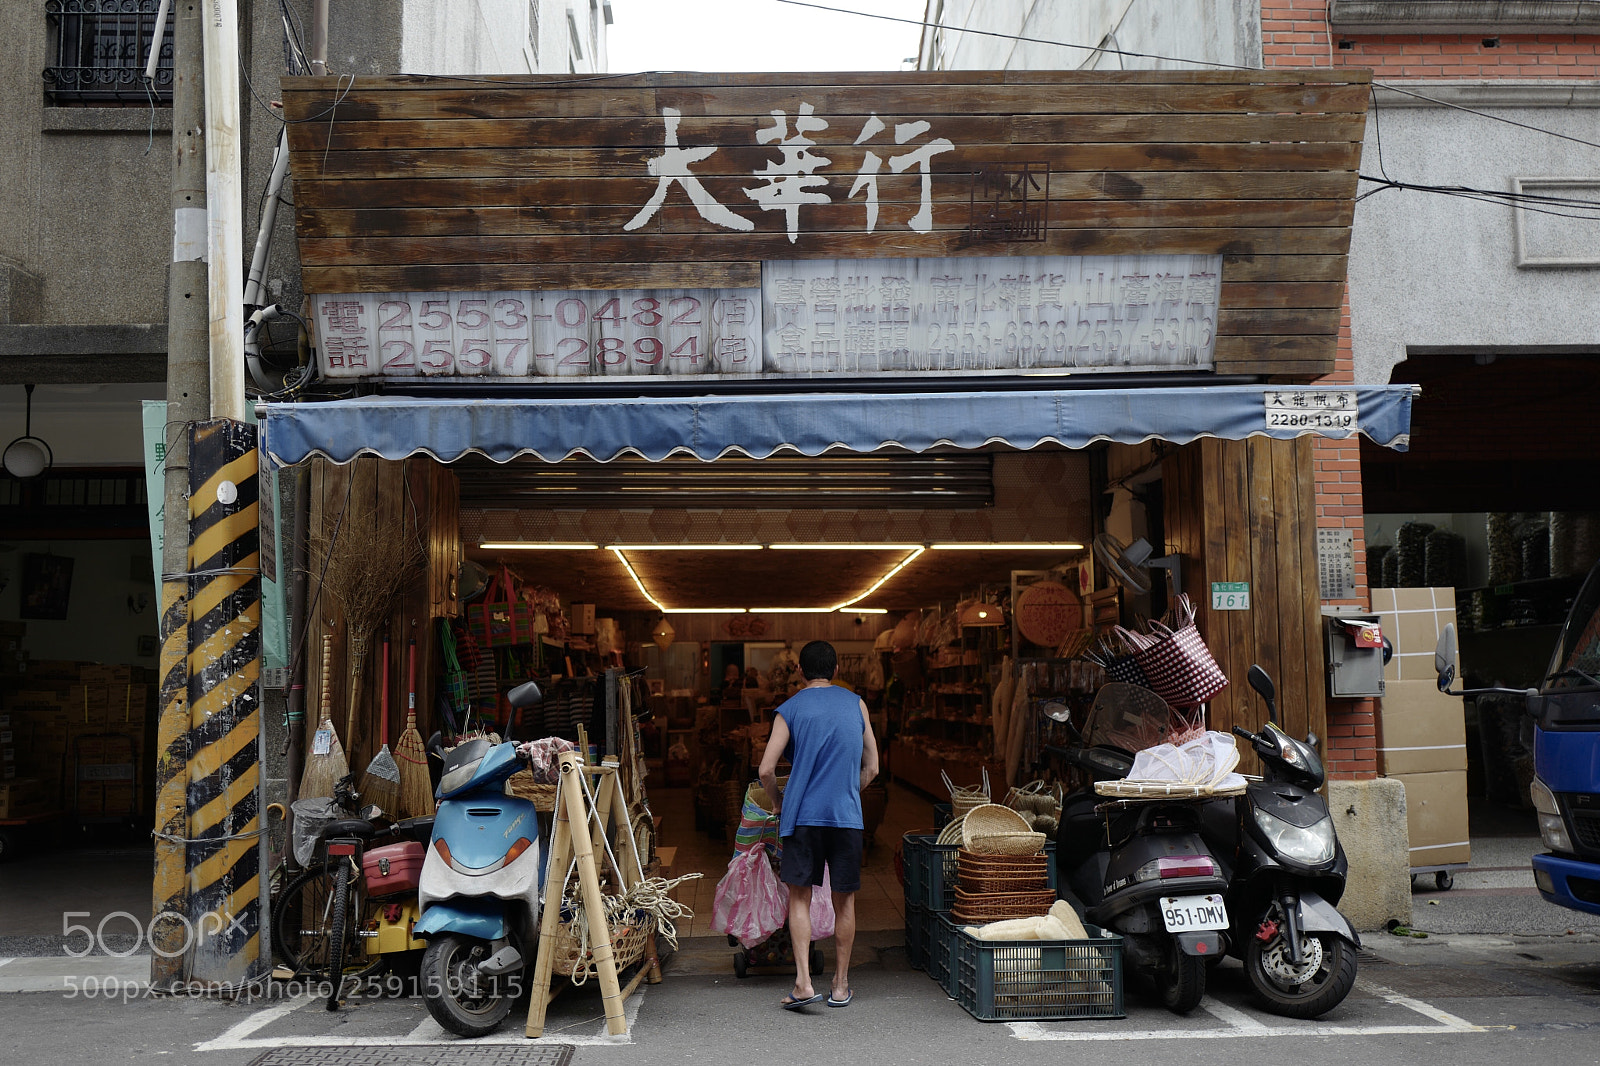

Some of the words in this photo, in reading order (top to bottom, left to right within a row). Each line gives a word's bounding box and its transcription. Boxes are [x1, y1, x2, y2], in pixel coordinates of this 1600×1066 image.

[623, 102, 955, 244] 大華行
[378, 297, 702, 332] 2553-0482
[322, 301, 370, 369] 電話
[381, 335, 705, 369] 2557-2894
[1271, 414, 1352, 427] 2280-1319
[1216, 594, 1246, 607] 161
